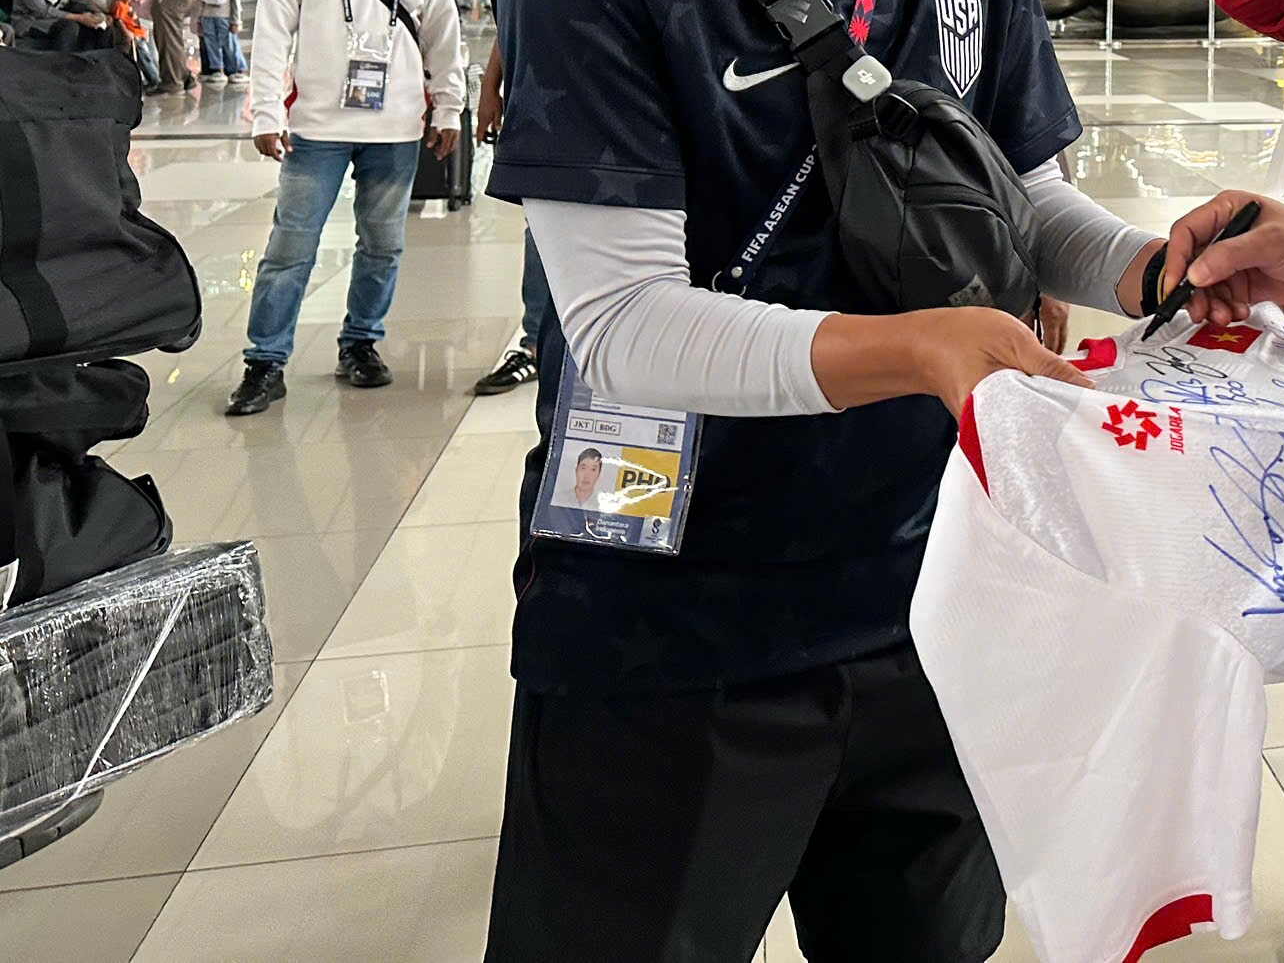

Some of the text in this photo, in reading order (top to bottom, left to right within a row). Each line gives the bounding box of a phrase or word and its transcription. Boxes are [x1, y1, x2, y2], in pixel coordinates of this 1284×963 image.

[741, 154, 816, 262] FIFA ASEAN CUP
[574, 421, 590, 430] JKT
